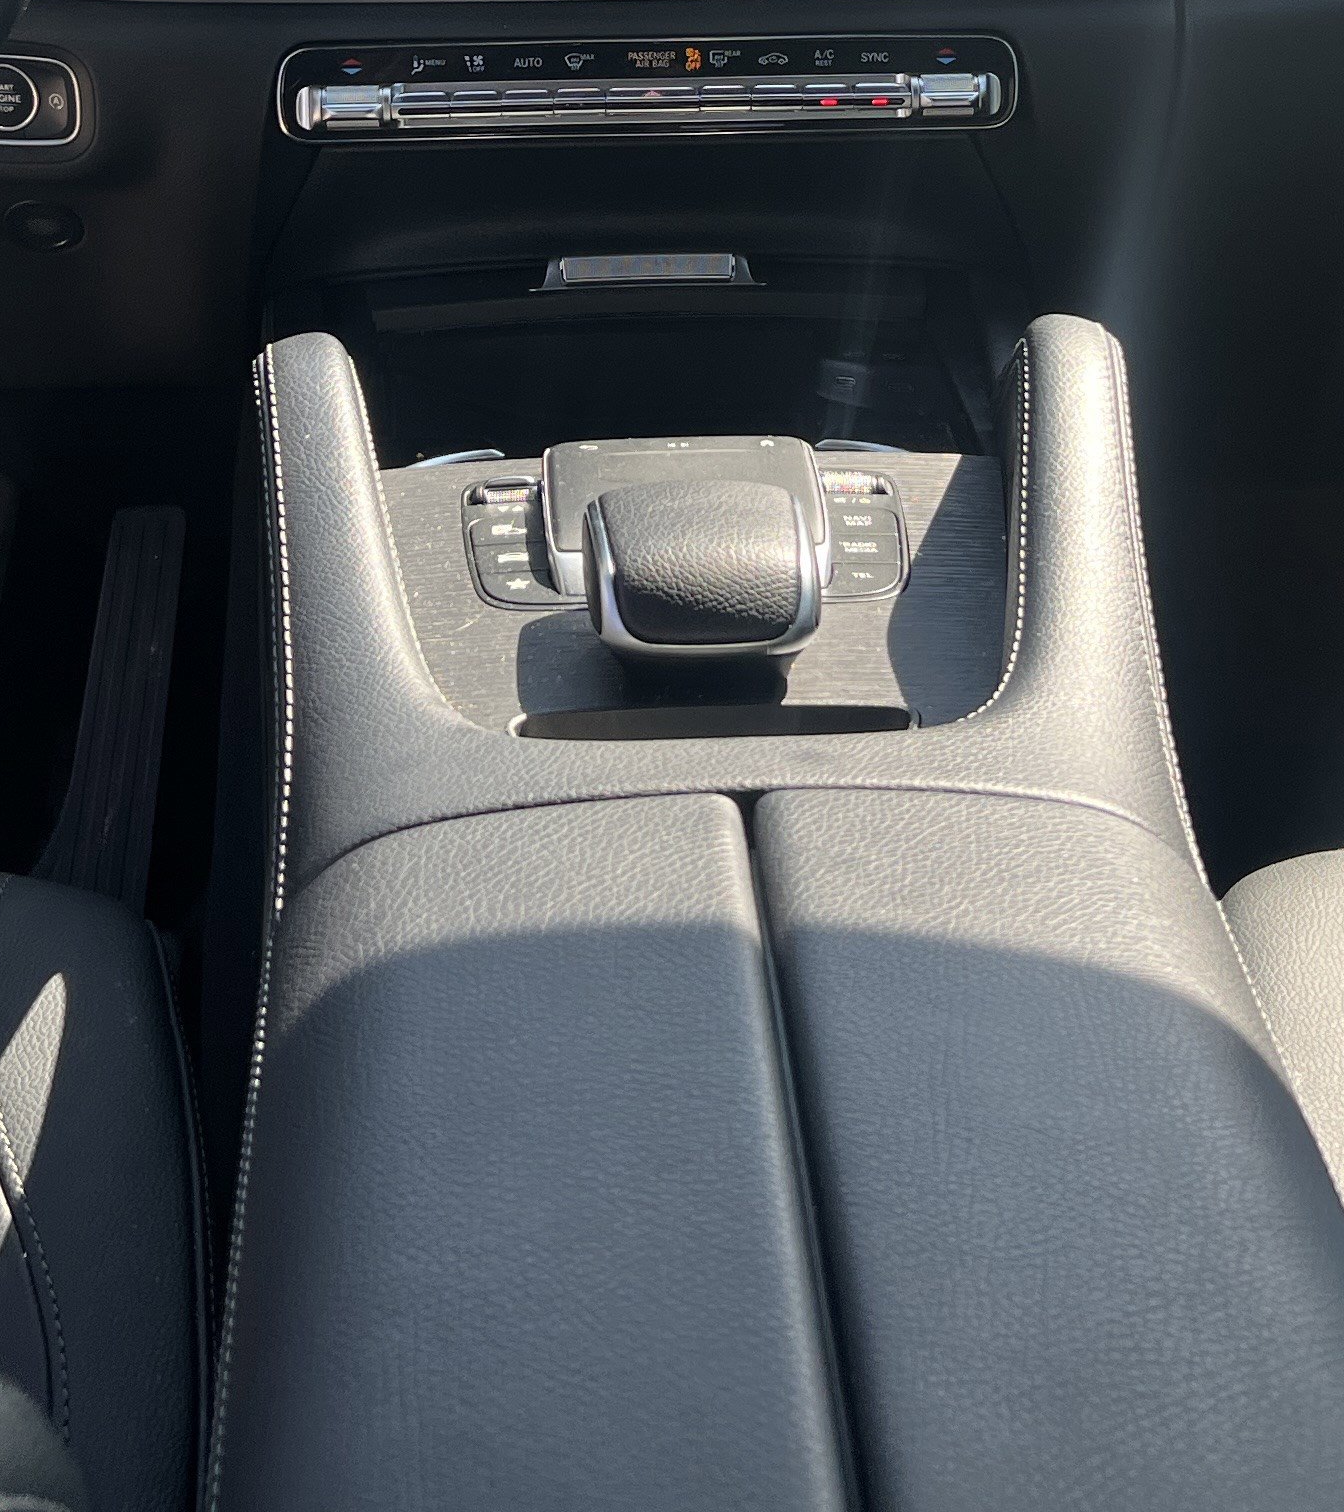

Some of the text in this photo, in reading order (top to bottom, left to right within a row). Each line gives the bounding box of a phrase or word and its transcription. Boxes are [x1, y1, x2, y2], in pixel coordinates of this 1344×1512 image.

[580, 53, 595, 61] MAX
[627, 50, 676, 60] PASSENGER
[814, 49, 835, 60] A/C
[860, 52, 889, 63] SYNC
[513, 57, 543, 68] AUTO
[636, 59, 670, 68] AIR BAG
[815, 59, 832, 67] REST
[851, 571, 874, 579] TEL
